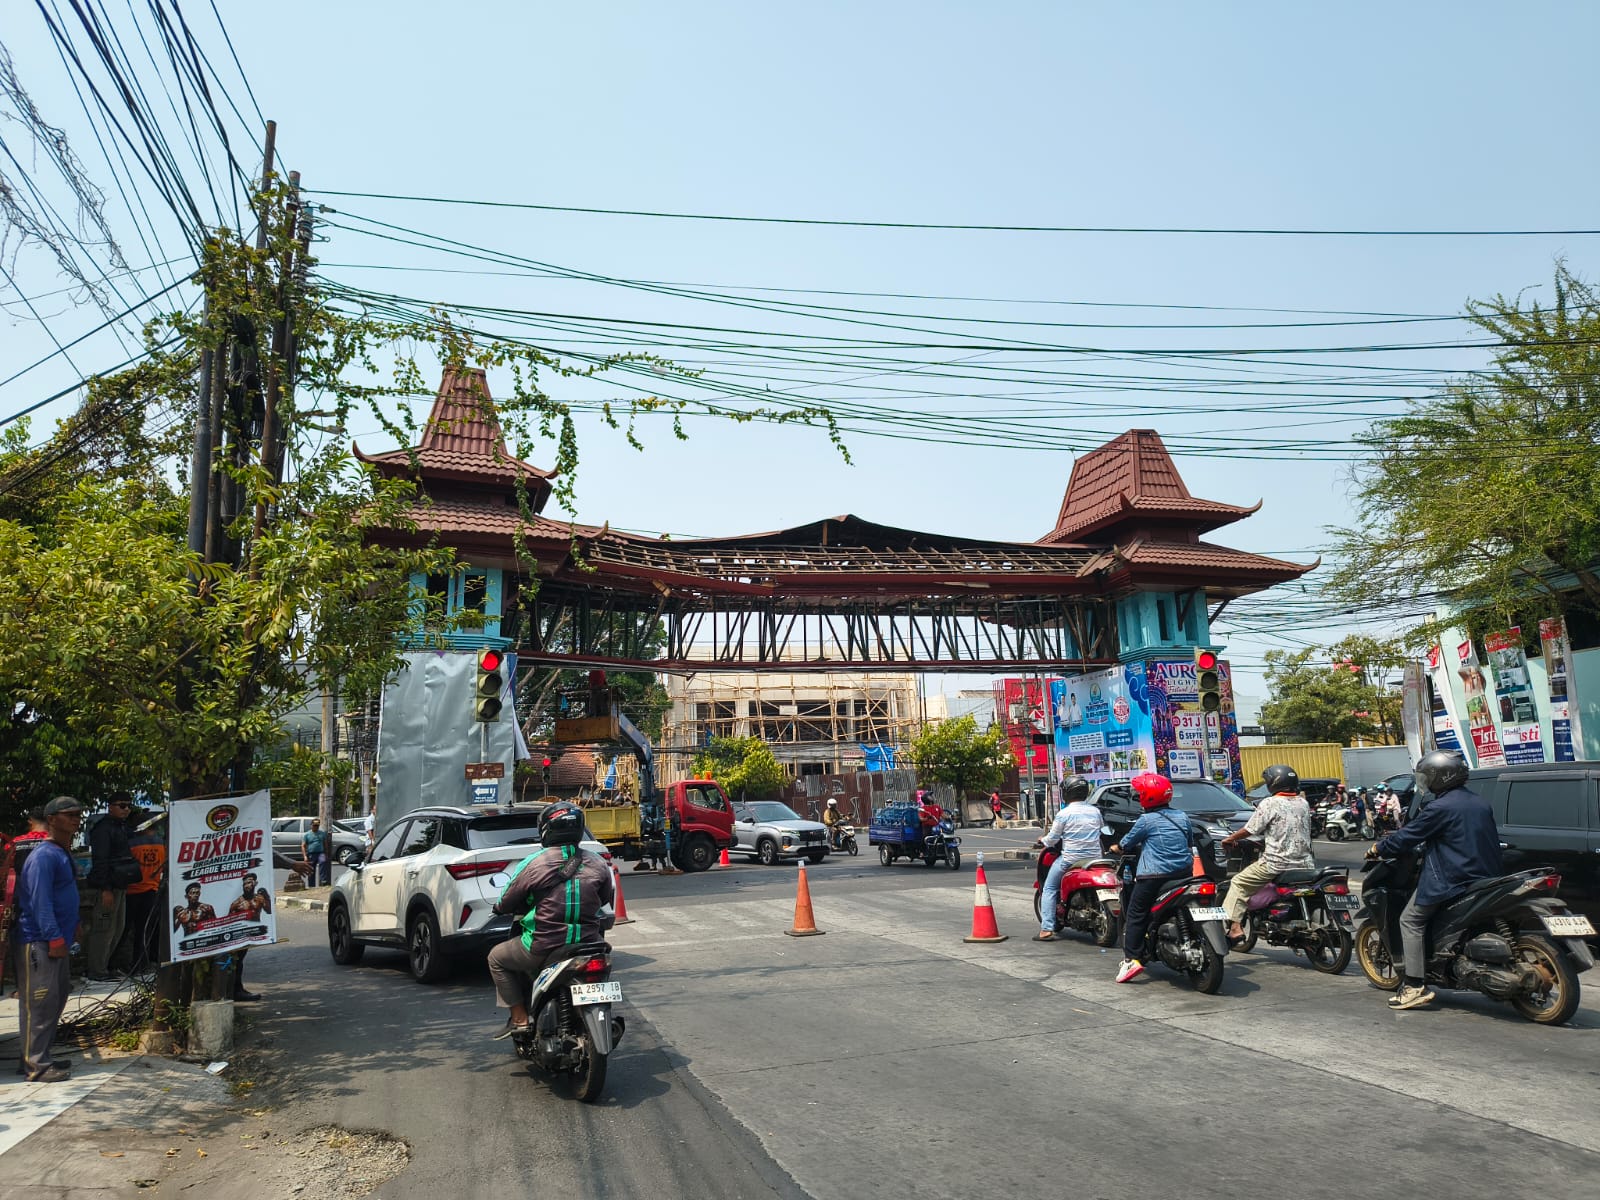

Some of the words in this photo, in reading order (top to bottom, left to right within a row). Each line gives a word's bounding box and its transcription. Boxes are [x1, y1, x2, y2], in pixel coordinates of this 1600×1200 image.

[1182, 716, 1193, 727] 31
[1195, 716, 1217, 727] JLI
[1179, 730, 1184, 740] 6
[1185, 731, 1218, 739] SEPTEBER
[200, 826, 242, 840] FREESTYLE
[177, 829, 264, 864] BOXING
[193, 852, 252, 869] ORGANIZATION
[190, 865, 220, 878] LEAGUE
[221, 860, 249, 872] SERIES
[205, 871, 242, 883] SEMARANG
[572, 987, 583, 995] AA
[586, 983, 605, 993] 2957
[610, 982, 620, 991] IB
